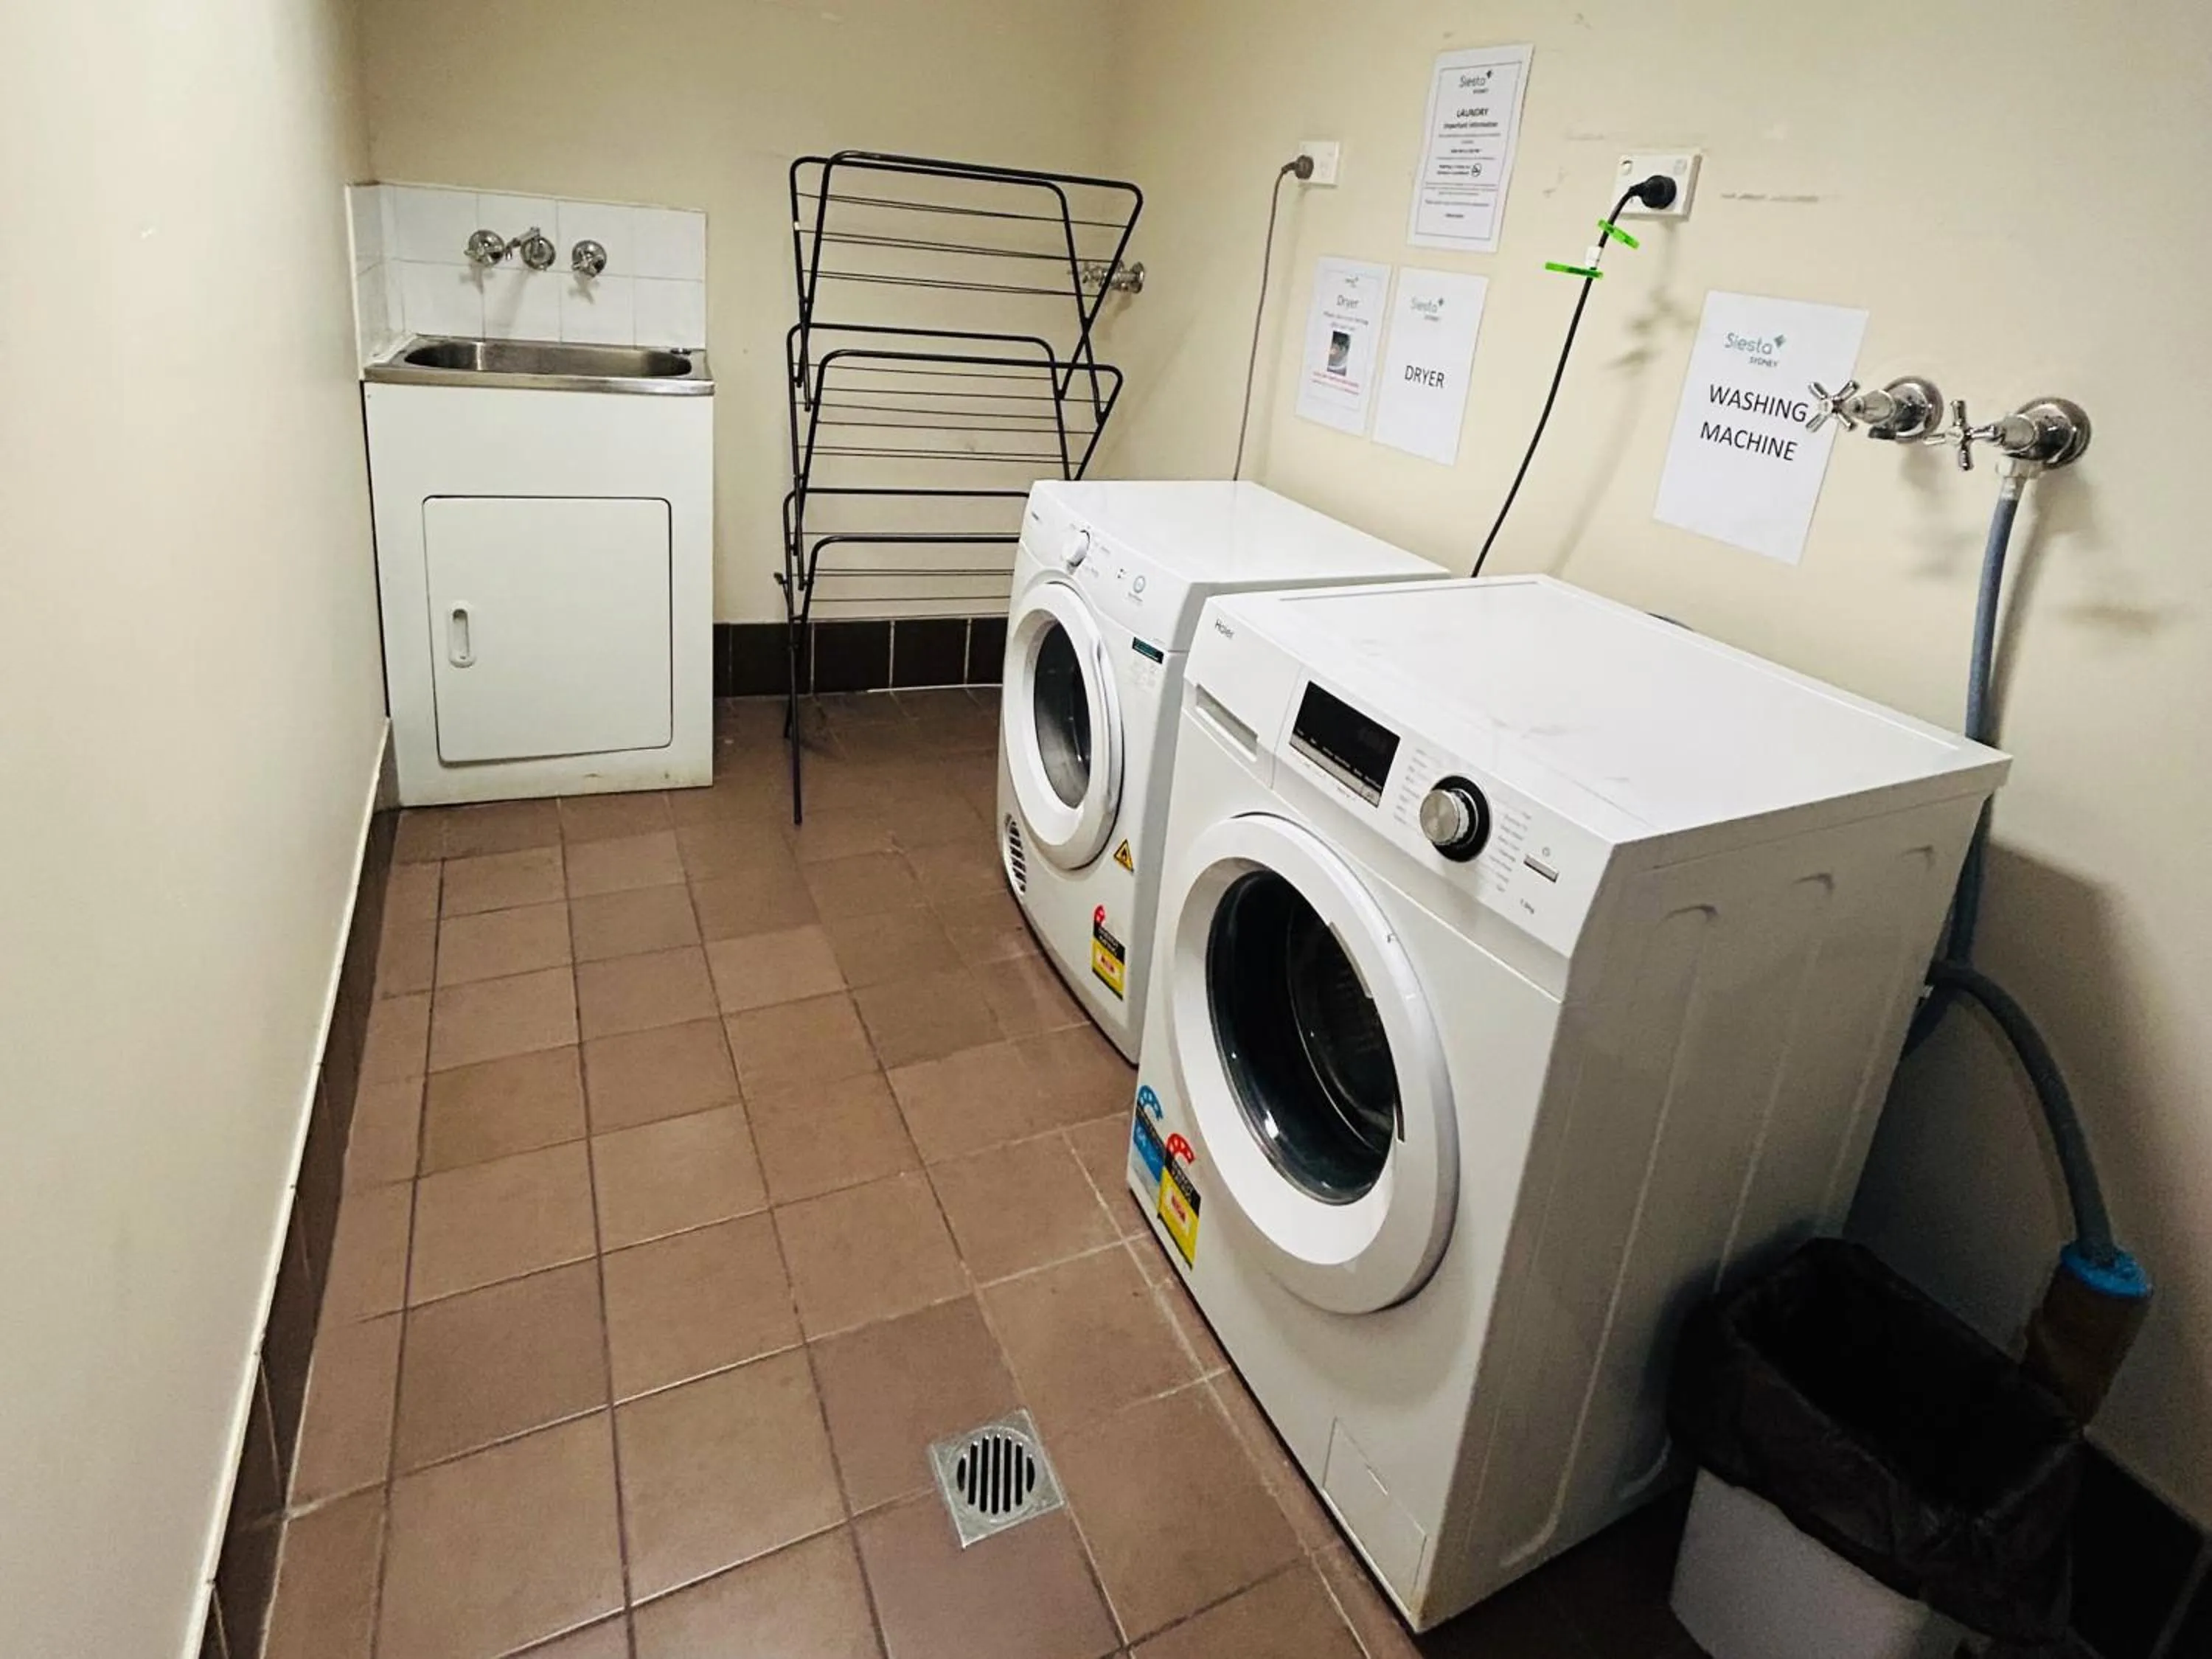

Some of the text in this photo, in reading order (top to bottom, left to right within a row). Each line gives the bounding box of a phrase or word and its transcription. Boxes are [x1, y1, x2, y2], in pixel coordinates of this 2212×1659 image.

[1456, 108, 1489, 118] LAUNDRY
[1337, 295, 1359, 310] Dryer
[1724, 332, 1773, 355] Siesta
[1405, 366, 1444, 388] DRYER
[1709, 384, 1809, 422] WASHING
[1700, 422, 1798, 462] MACHINE
